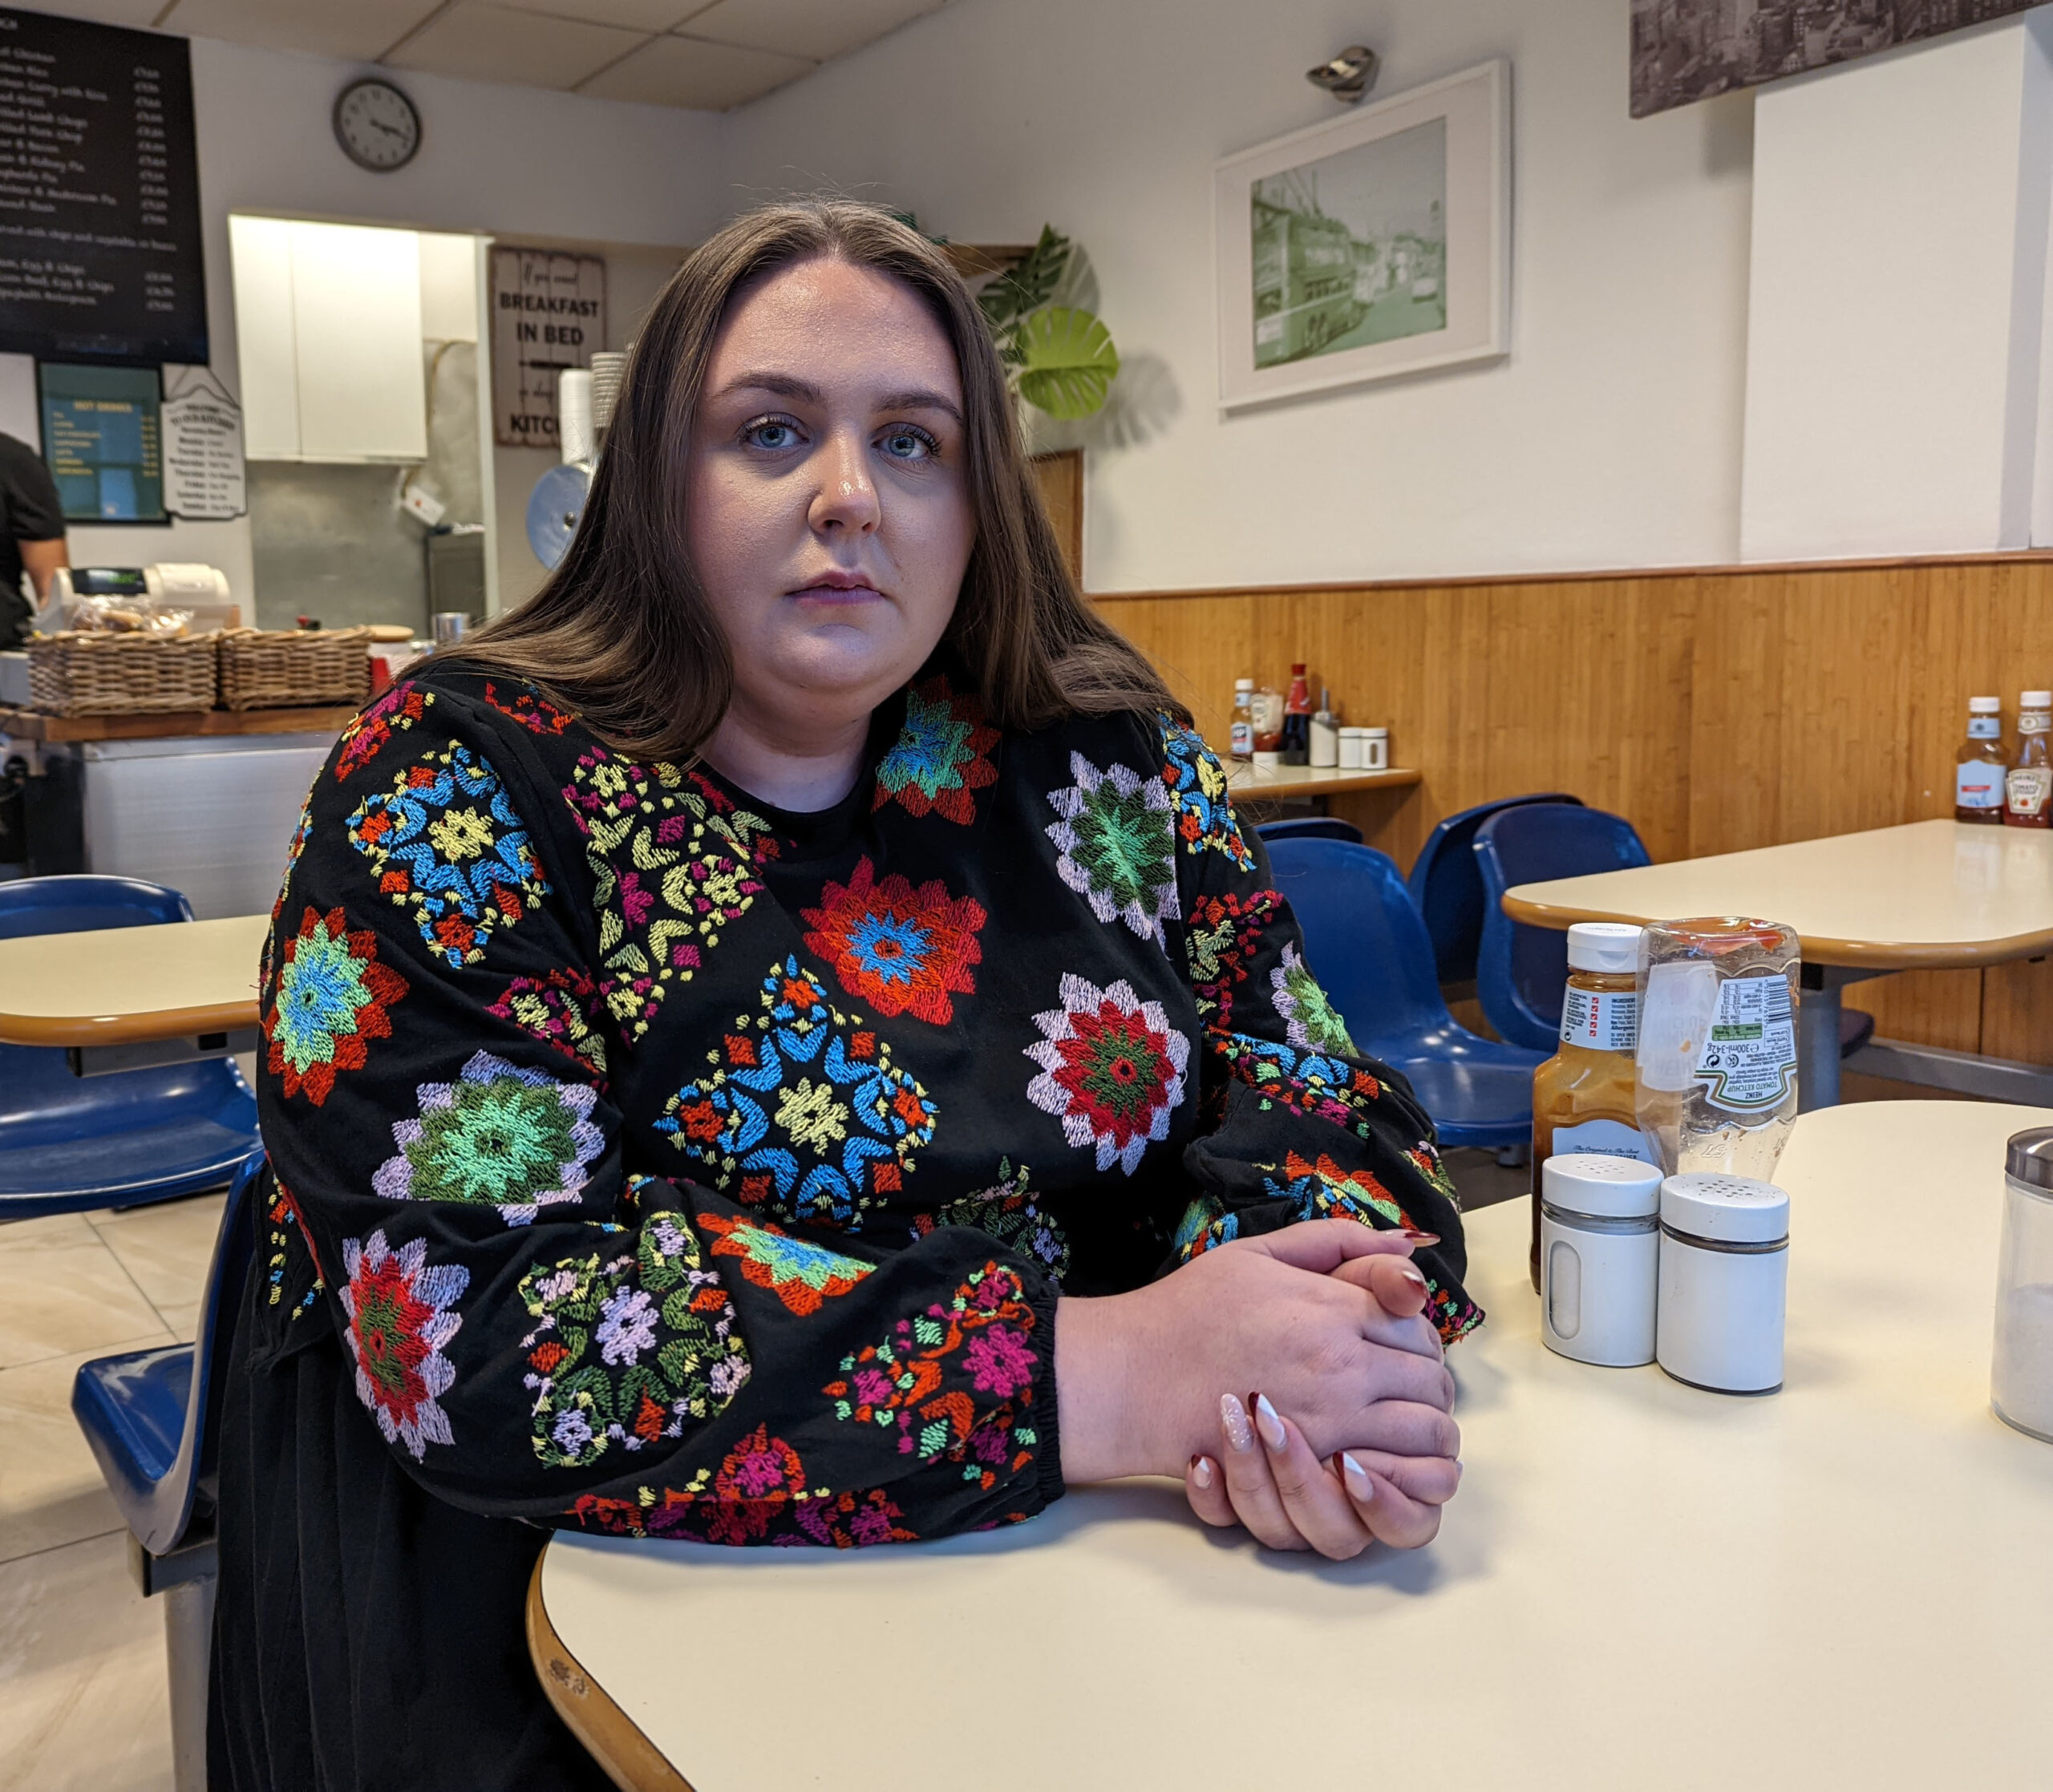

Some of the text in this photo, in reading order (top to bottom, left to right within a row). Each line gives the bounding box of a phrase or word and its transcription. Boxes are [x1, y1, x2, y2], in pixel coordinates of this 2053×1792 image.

[499, 291, 598, 318] BREAKFAST
[516, 322, 585, 346] IN BED
[1727, 1081, 1777, 1093] TOMATO KETCHUP
[1745, 1091, 1763, 1099] HEINZ
